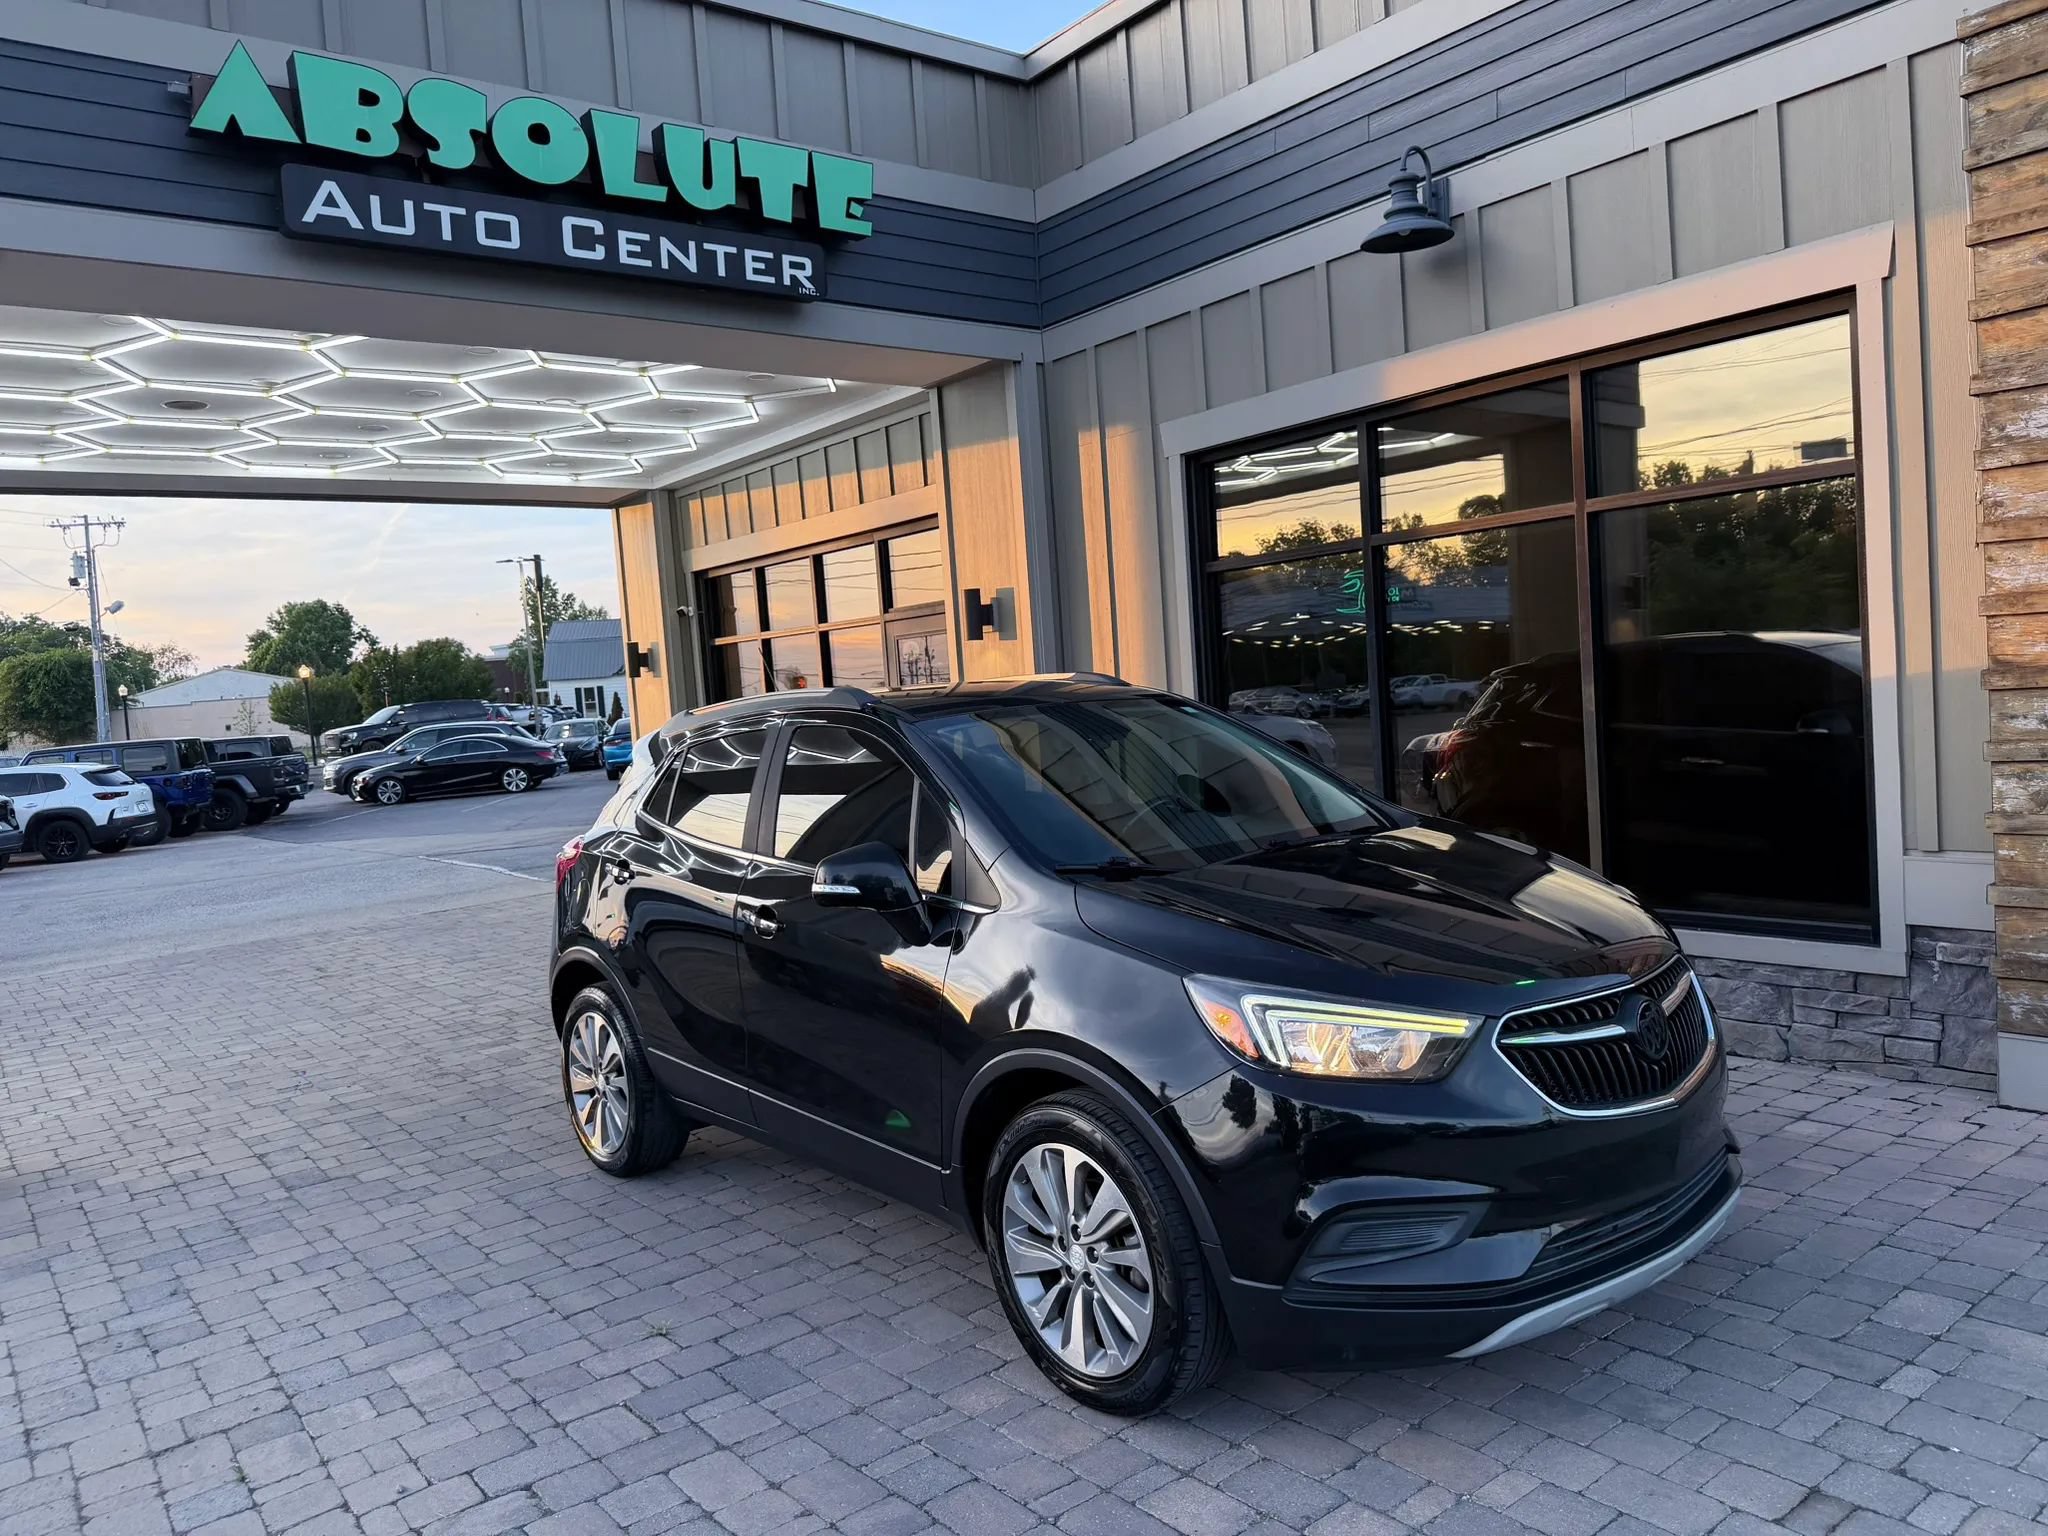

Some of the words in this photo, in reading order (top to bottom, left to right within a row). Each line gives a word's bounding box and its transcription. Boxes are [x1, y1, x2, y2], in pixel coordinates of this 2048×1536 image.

[189, 39, 874, 237] ABSOLUTE
[301, 180, 521, 250] AUTO
[562, 215, 815, 289] CENTER
[799, 286, 820, 296] INC.
